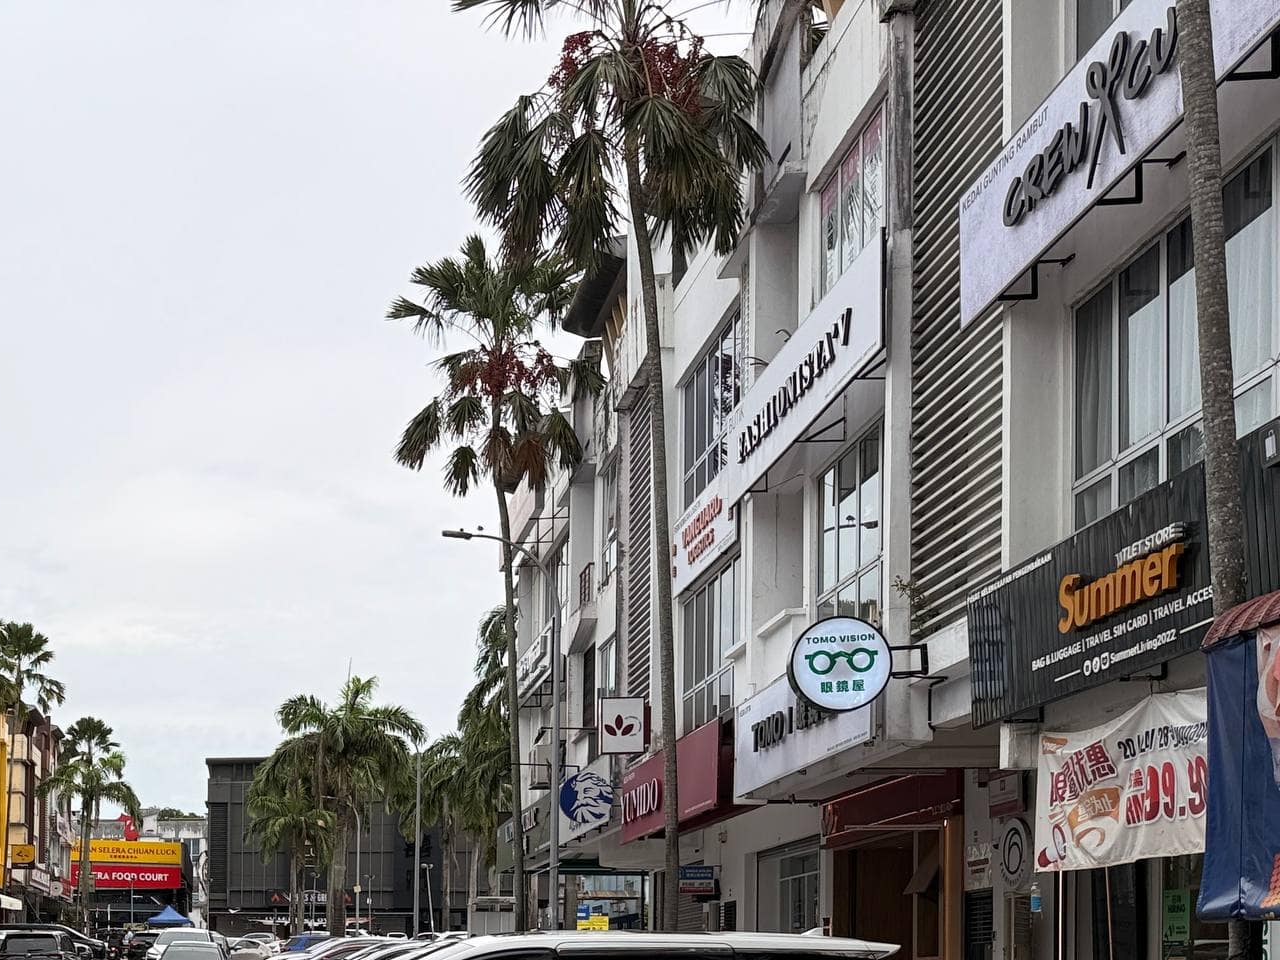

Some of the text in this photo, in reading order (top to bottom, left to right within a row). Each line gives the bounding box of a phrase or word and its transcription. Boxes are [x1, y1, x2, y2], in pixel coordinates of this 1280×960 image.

[1124, 6, 1177, 100] CU
[961, 106, 1050, 213] KEDAI GUNTING RAMBUT
[1144, 522, 1181, 550] STORE
[1058, 543, 1185, 634] Summer
[805, 632, 876, 645] TOMO VISION
[1031, 655, 1045, 671] BAG
[1051, 643, 1082, 666] LUGGAGE
[1085, 631, 1113, 648] TRAVEL
[1113, 625, 1126, 639] SIM
[1127, 613, 1148, 633] CARD
[1153, 600, 1185, 622] TRAVEL
[1186, 585, 1213, 607] ACCES
[820, 679, 865, 693] 眼鏡屋
[751, 710, 785, 753] TOMO
[1117, 737, 1137, 760] 20
[620, 778, 658, 825] YUMIDO
[98, 847, 125, 855] SELERA
[127, 847, 155, 855] CHUAN
[156, 848, 177, 856] LUCK
[112, 872, 138, 882] FOOD
[139, 872, 169, 882] COURT
